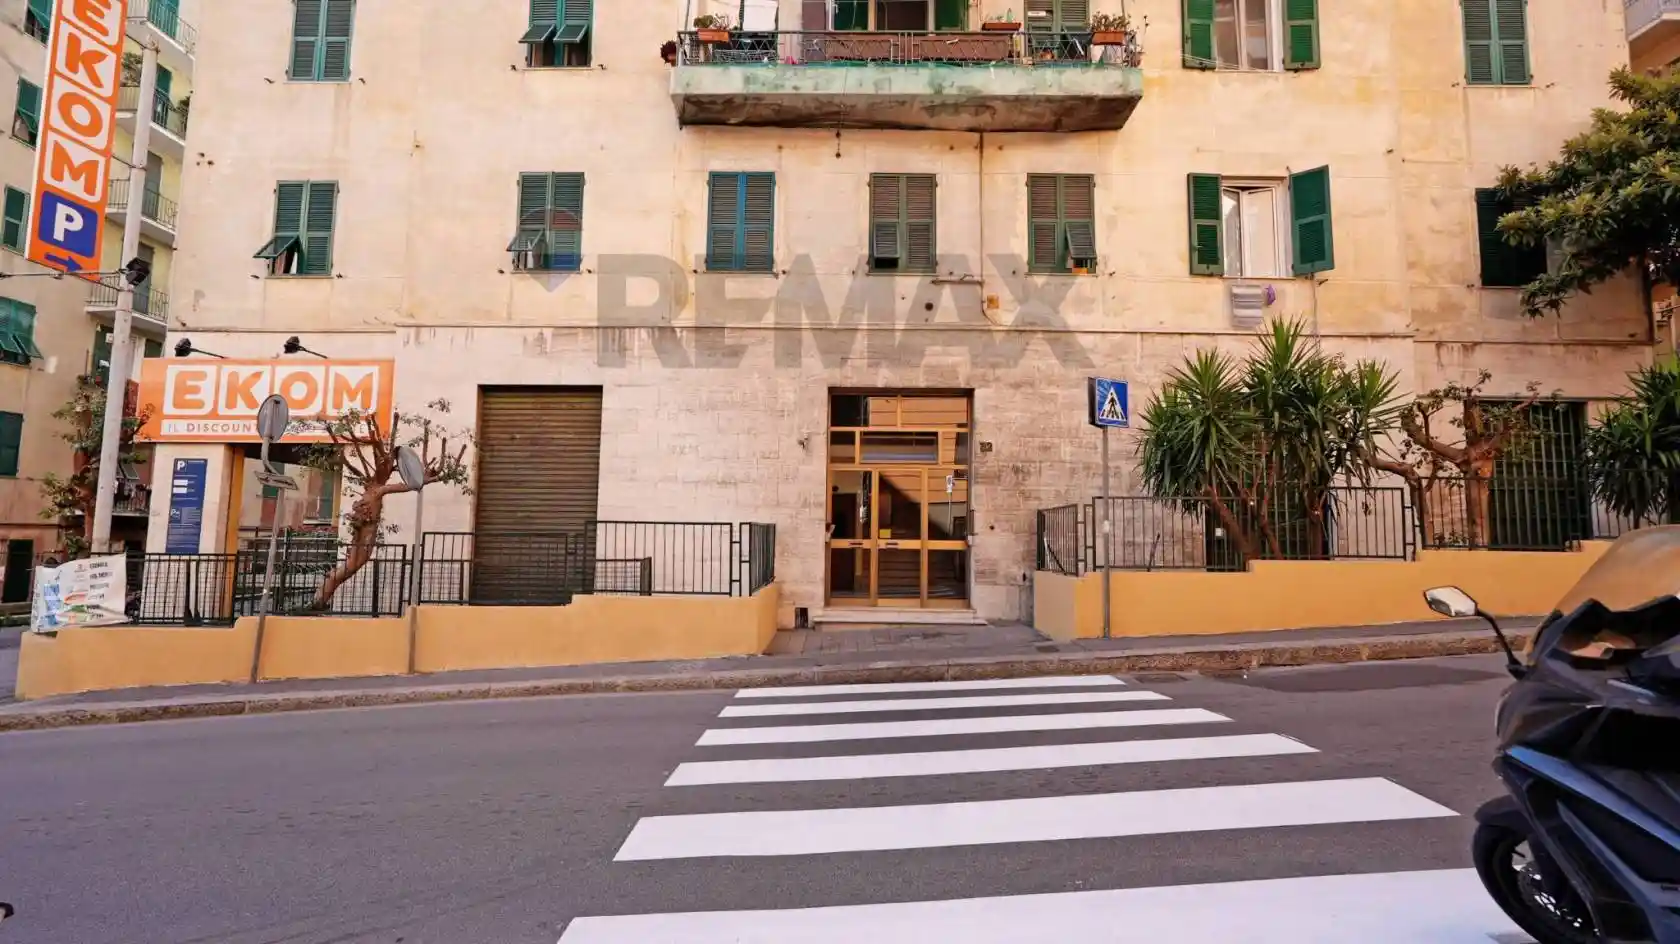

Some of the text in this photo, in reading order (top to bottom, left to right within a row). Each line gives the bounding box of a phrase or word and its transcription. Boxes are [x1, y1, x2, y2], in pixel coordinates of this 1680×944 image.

[51, 0, 111, 197] EKOM
[53, 202, 84, 242] P
[172, 370, 374, 410] EKOM
[168, 423, 258, 433] IL DISCOUN
[177, 461, 186, 471] P
